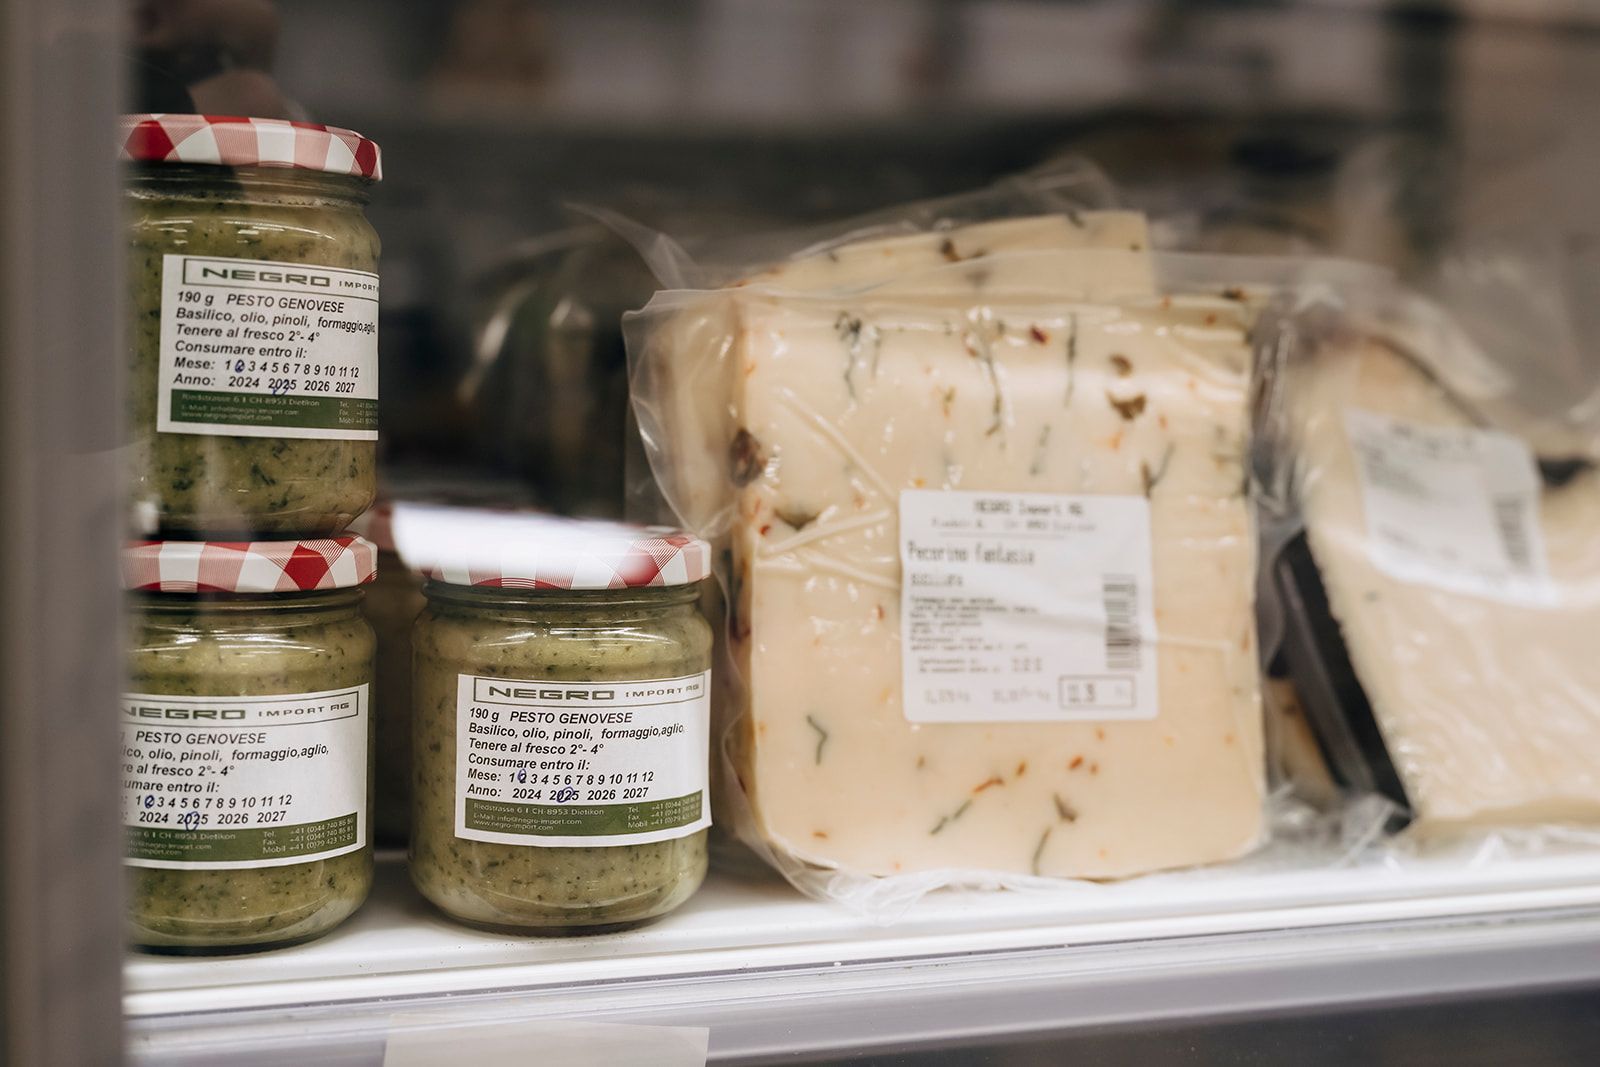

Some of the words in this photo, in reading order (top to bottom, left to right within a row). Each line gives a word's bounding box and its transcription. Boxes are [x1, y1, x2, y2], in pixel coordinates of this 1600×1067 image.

[203, 267, 330, 287] NEGRO
[178, 291, 201, 303] 190
[205, 294, 214, 306] g
[227, 293, 275, 307] PESTO
[279, 297, 345, 313] GENOVESE
[176, 307, 235, 323] Basilico,
[240, 312, 268, 325] olio,
[272, 314, 310, 328] pinoli,
[177, 324, 223, 338] Tenere
[226, 327, 239, 338] al
[243, 328, 284, 340] fresco
[175, 340, 255, 356] Consumare
[259, 346, 292, 358] entro
[295, 347, 307, 358] il:
[174, 357, 216, 370] Mese:
[225, 360, 232, 370] 1
[248, 360, 256, 372] 3
[260, 362, 268, 372] 4
[272, 362, 279, 373] 5
[282, 362, 290, 374] 6
[294, 364, 301, 374] 7
[304, 364, 311, 375] 8
[314, 364, 321, 376] 9
[324, 365, 336, 376] 10
[339, 366, 348, 378] 11
[350, 367, 360, 378] 12
[173, 373, 216, 386] Anno:
[228, 376, 260, 388] 2024
[268, 378, 297, 390] 2025
[304, 380, 330, 392] 2026
[335, 382, 356, 393] 2027
[489, 686, 615, 700] NEGRO
[626, 687, 683, 698] IMPORT
[258, 706, 326, 717] IMPORT
[330, 702, 350, 712] AG
[470, 708, 488, 720] 190
[492, 711, 500, 722] g
[510, 711, 555, 724] PESTO
[559, 712, 633, 724] GENOVESE
[136, 731, 182, 744] PESTO
[186, 732, 267, 744] GENOVESE
[469, 722, 518, 738] Basilico,
[522, 728, 550, 740] olio,
[554, 728, 594, 741] pinoli,
[469, 738, 508, 752] Tenere
[510, 742, 522, 752] al
[525, 742, 566, 754] fresco
[149, 748, 176, 761] olio,
[180, 750, 223, 762] pinoli,
[468, 752, 537, 768] Consumare
[540, 760, 574, 770] entro
[578, 760, 590, 770] il:
[136, 763, 148, 774] al
[152, 764, 194, 776] fresco
[468, 768, 502, 782] Mese:
[509, 772, 515, 782] 1
[530, 774, 538, 784] 3
[541, 774, 549, 784] 4
[552, 775, 560, 785] 5
[564, 775, 572, 786] 6
[576, 775, 584, 785] 7
[586, 774, 594, 785] 8
[598, 774, 606, 785] 9
[609, 774, 623, 784] 10
[626, 772, 638, 783] 11
[642, 772, 654, 782] 12
[167, 782, 202, 792] entro
[206, 782, 220, 793] il:
[467, 784, 502, 797] Anno:
[512, 788, 542, 800] 2024
[549, 790, 580, 801] 2025
[587, 790, 616, 800] 2026
[622, 787, 649, 799] 2027
[136, 795, 141, 806] 1
[157, 796, 165, 808] 3
[168, 798, 176, 808] 4
[180, 798, 188, 808] 5
[192, 798, 200, 808] 6
[205, 798, 212, 808] 7
[216, 798, 224, 808] 8
[228, 798, 236, 808] 9
[242, 797, 256, 808] 10
[261, 796, 274, 807] 11
[279, 794, 292, 806] 12
[140, 812, 169, 823] 2024
[177, 813, 209, 825] 2025
[218, 813, 249, 824] 2026
[257, 811, 286, 823] 2027
